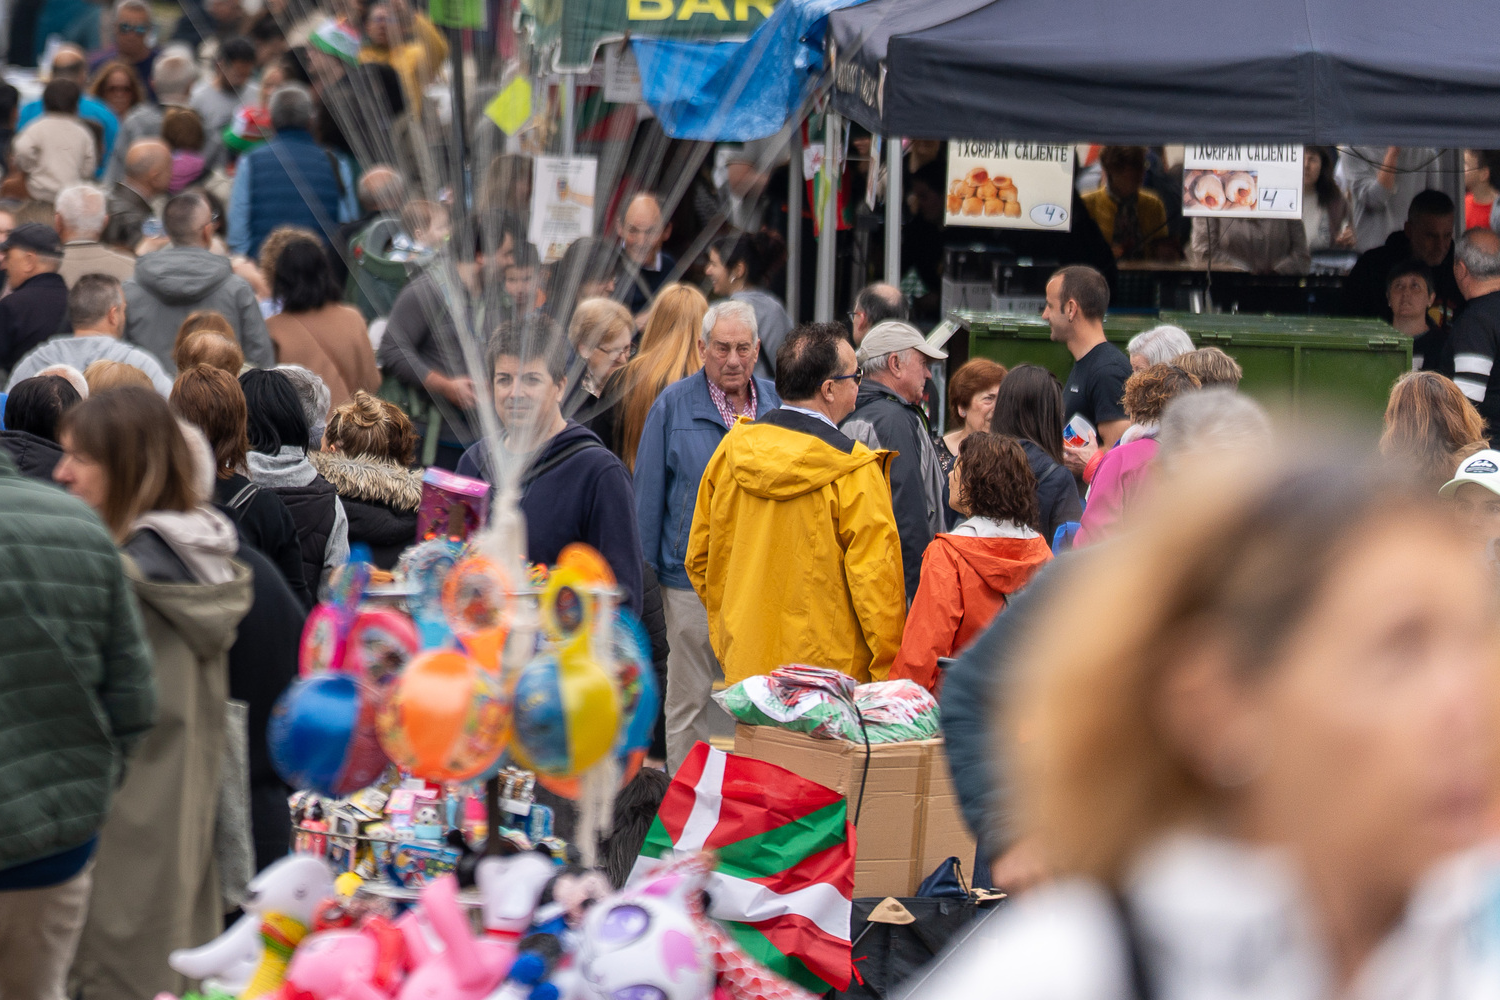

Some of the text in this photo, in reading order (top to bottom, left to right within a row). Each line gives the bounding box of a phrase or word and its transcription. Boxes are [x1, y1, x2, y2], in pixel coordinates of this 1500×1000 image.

[957, 141, 1068, 162] TXORIPAN CALIENTE
[1246, 145, 1298, 162] CALIENTE
[1263, 190, 1278, 208] 4
[1045, 206, 1056, 221] 4
